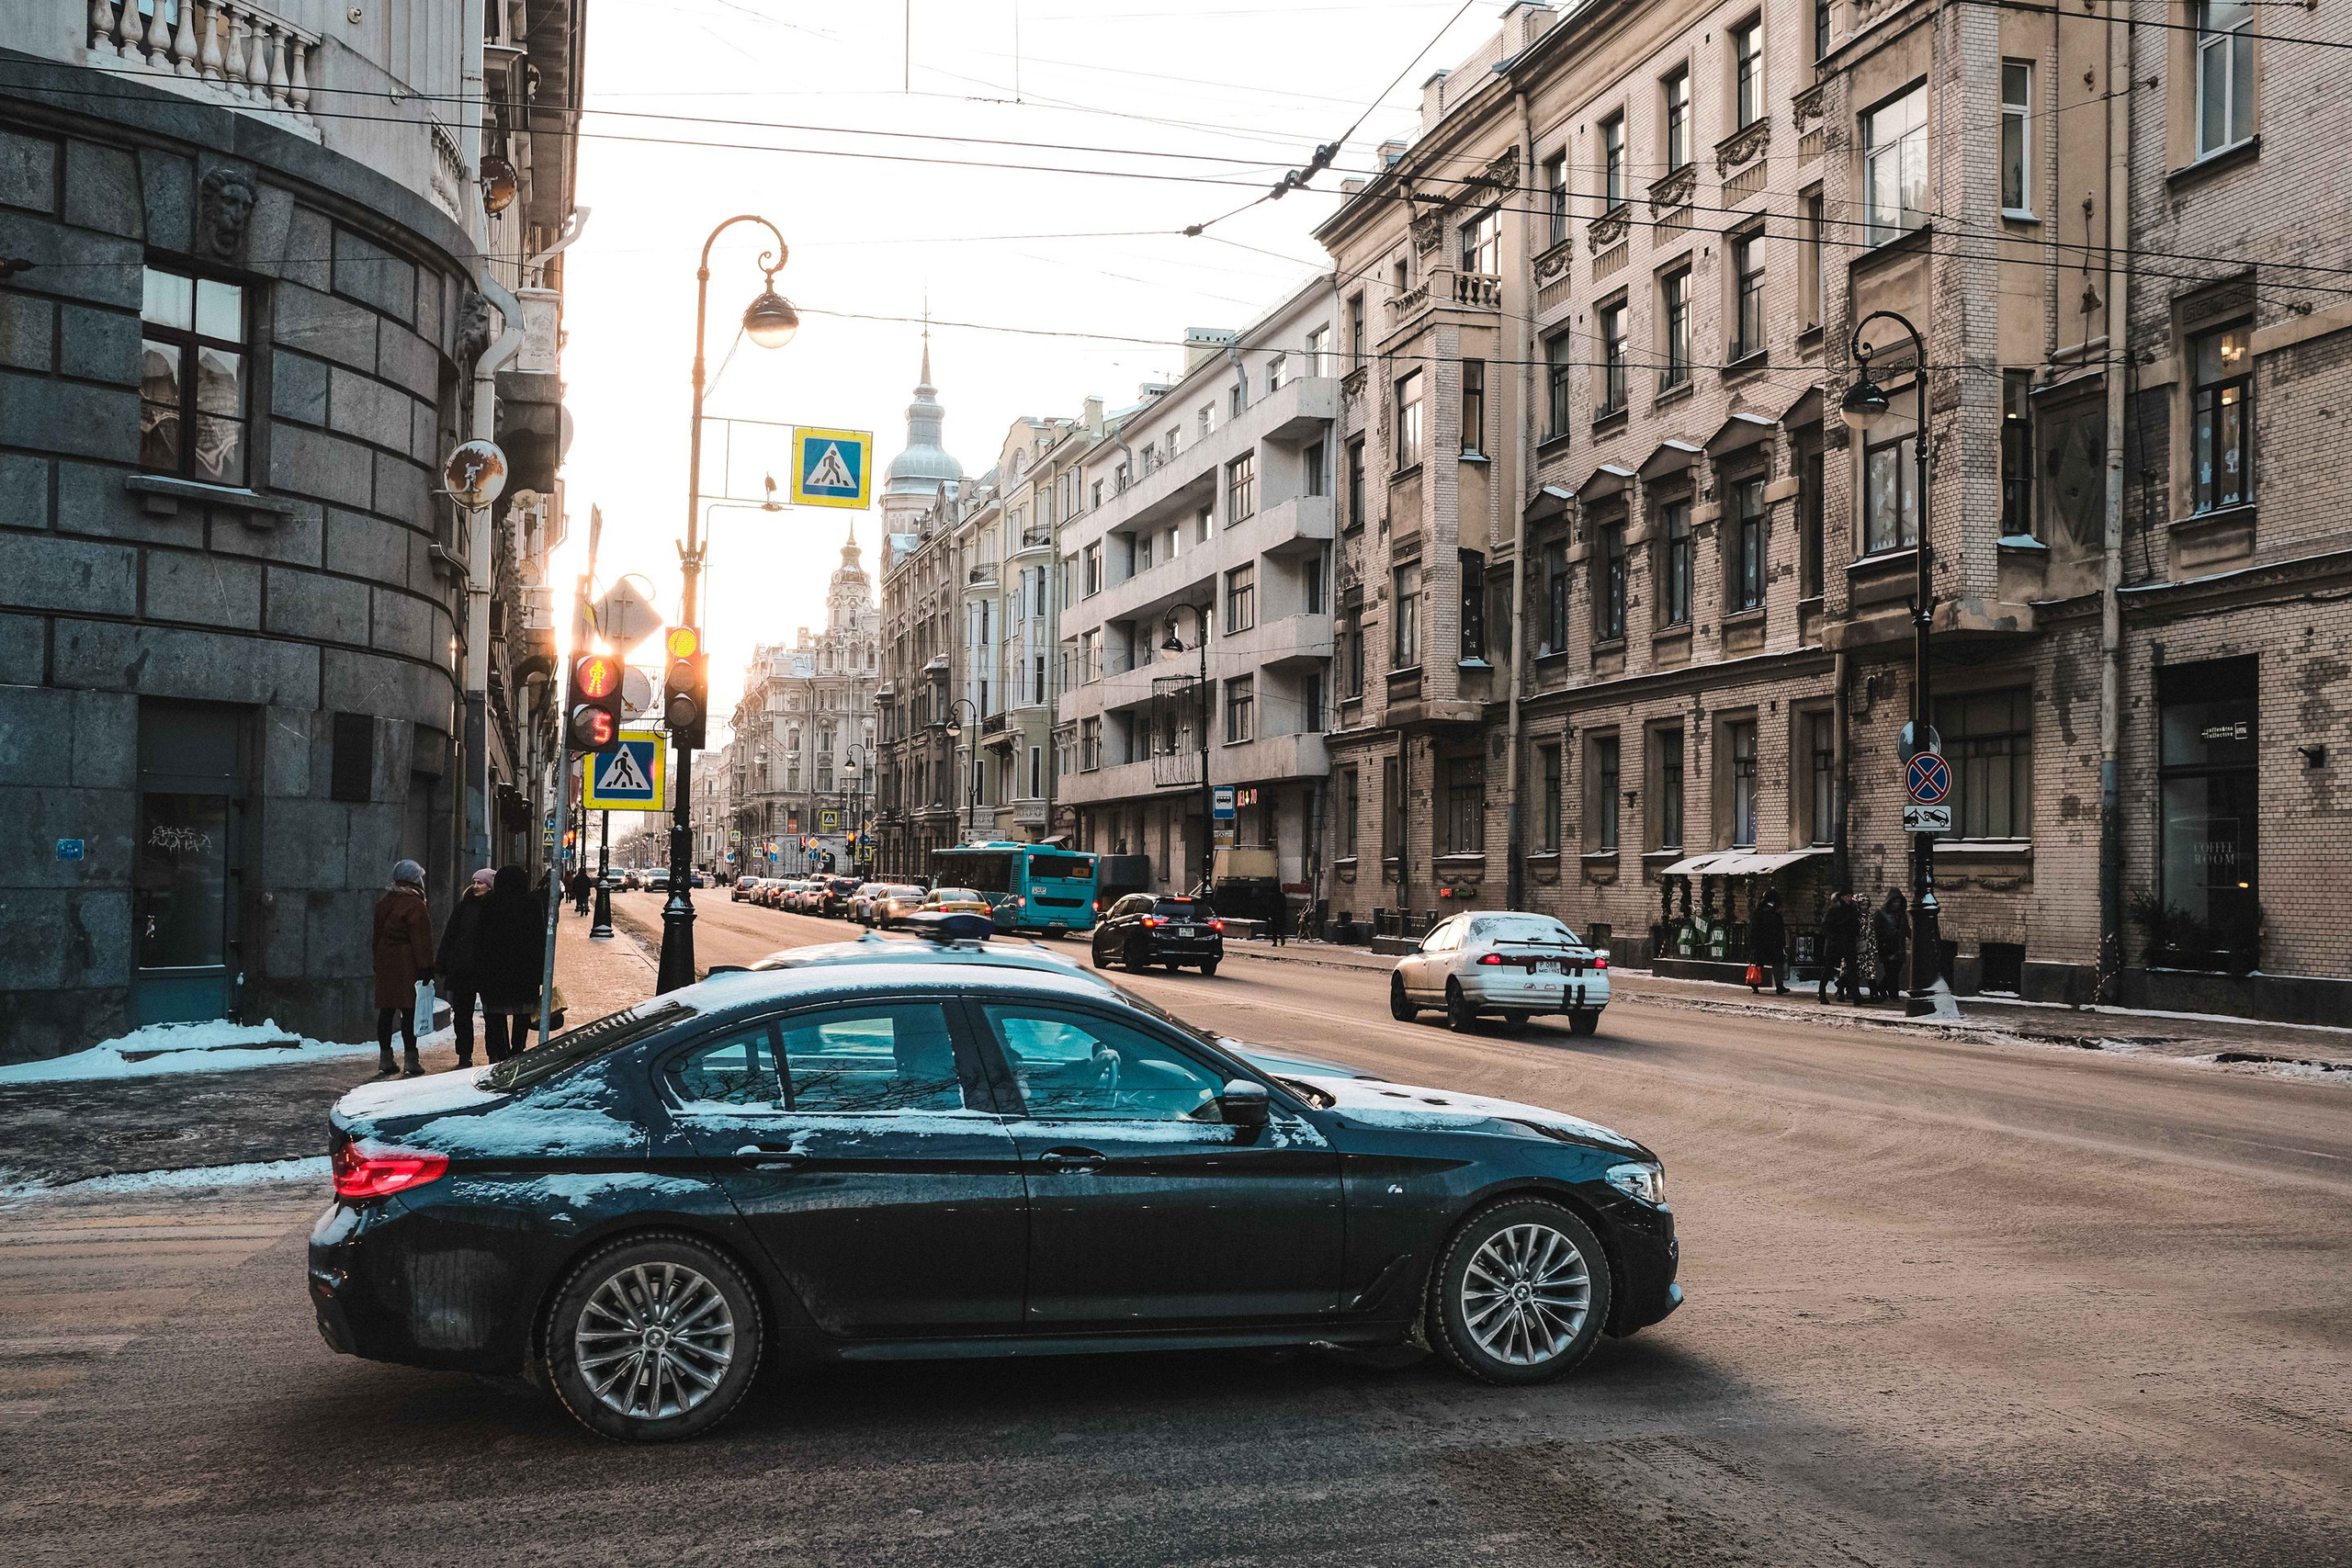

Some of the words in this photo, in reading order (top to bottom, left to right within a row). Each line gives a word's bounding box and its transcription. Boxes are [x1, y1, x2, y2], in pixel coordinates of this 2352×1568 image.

[594, 712, 612, 743] 5
[2194, 841, 2234, 853] COFFEE
[2194, 853, 2234, 864] ROOM
